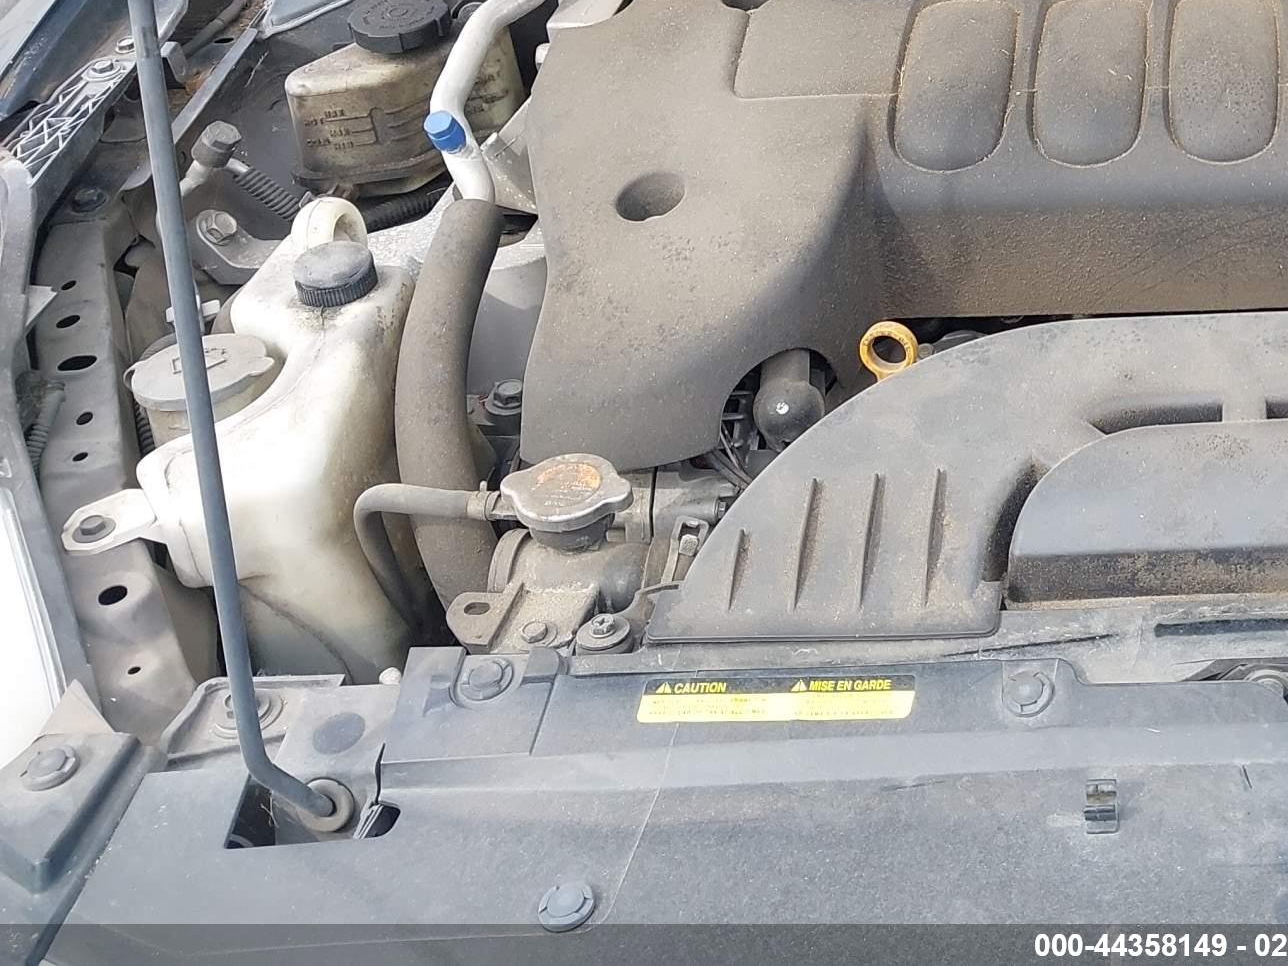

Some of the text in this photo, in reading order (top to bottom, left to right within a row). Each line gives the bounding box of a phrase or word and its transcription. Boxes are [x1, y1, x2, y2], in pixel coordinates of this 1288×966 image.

[674, 682, 727, 694] CAUTION
[808, 679, 892, 692] MISE EN GARDE
